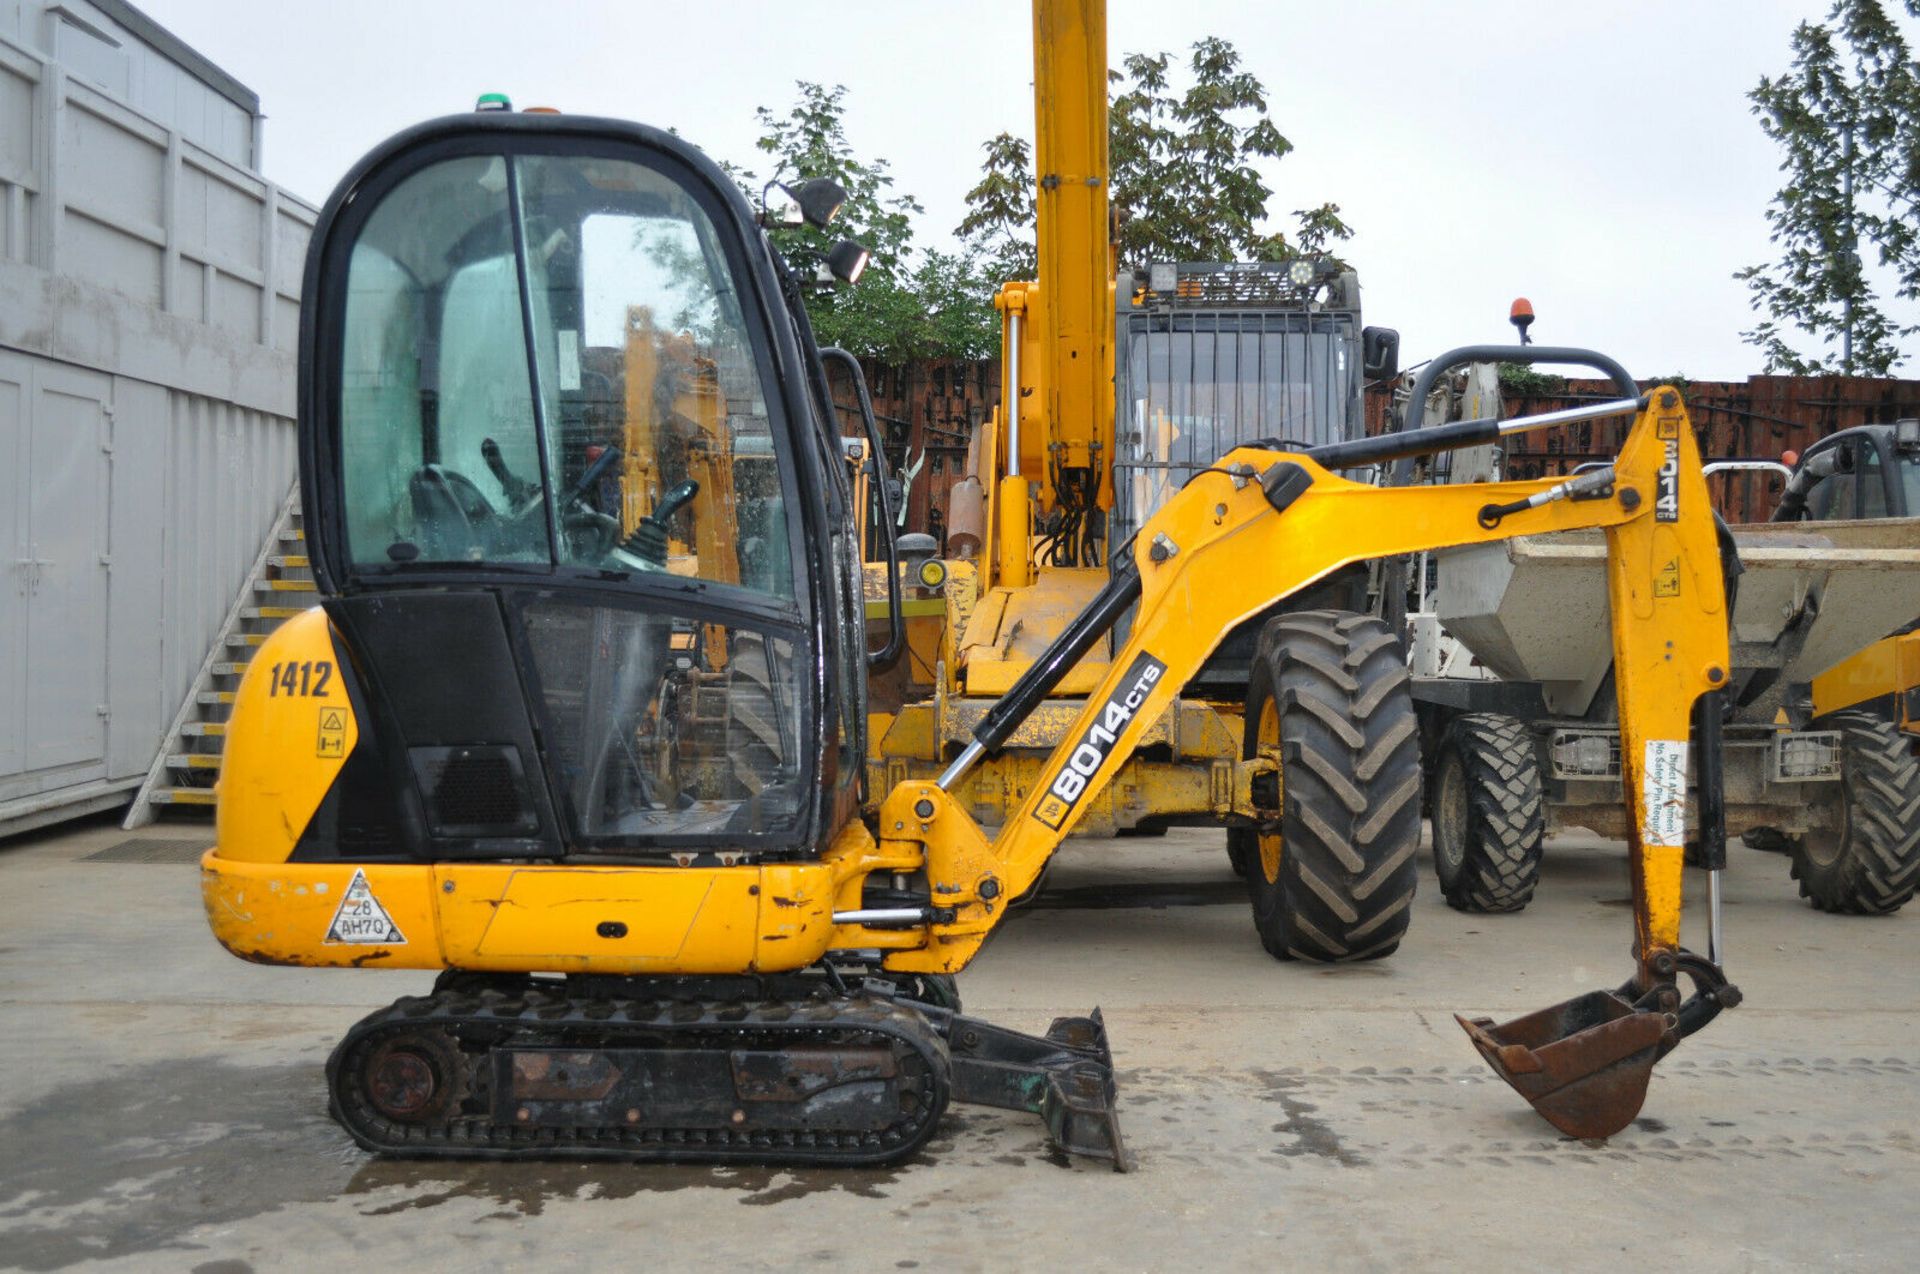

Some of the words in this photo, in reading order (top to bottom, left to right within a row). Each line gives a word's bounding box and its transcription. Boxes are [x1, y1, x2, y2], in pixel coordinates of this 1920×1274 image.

[270, 661, 332, 697] 1412
[1655, 742, 1665, 755] No
[1653, 756, 1665, 783] Safety
[1668, 754, 1679, 780] Direct
[1653, 787, 1663, 801] Pin
[1666, 783, 1677, 832] Attahment
[342, 919, 384, 936] AH7Q
